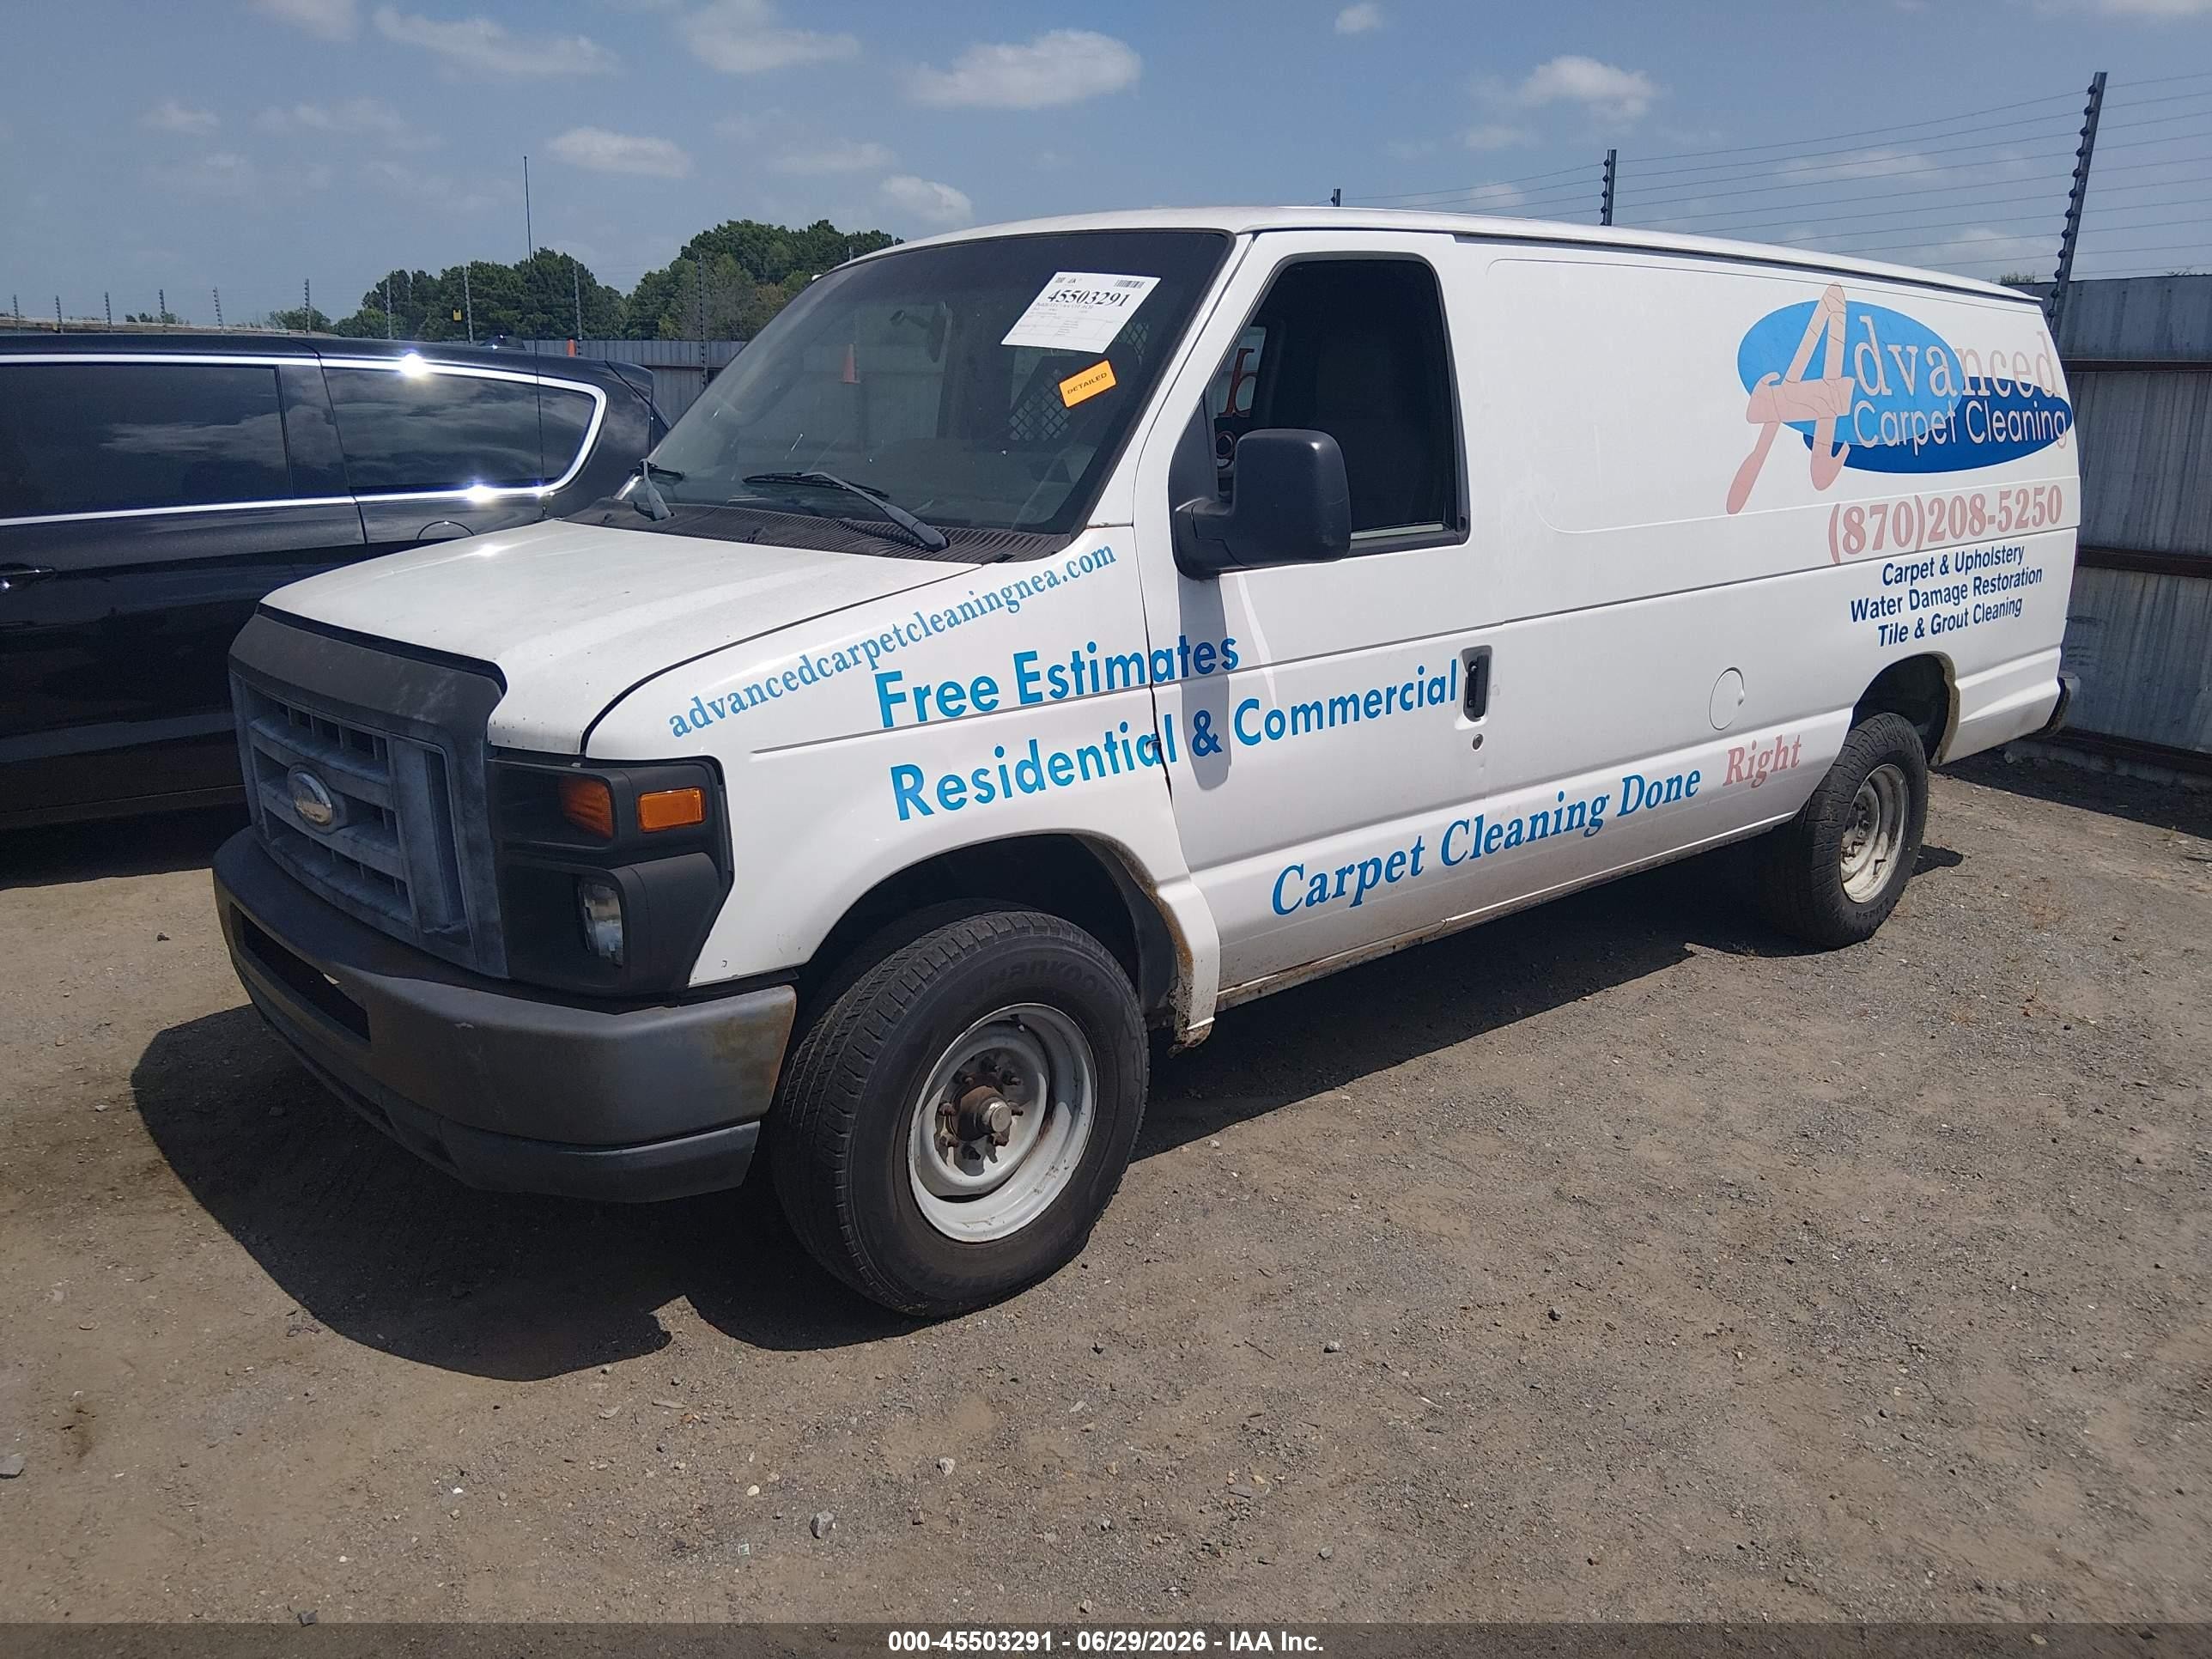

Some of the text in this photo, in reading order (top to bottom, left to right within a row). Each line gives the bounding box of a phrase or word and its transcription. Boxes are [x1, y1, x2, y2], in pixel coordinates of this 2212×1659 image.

[1048, 289, 1132, 307] 45503291
[1066, 372, 1108, 394] DETAILED
[1726, 282, 2062, 514] Advanced
[1853, 400, 2068, 455] Carpet Cleaning
[1828, 484, 2062, 565] (870)208-5250
[1850, 567, 2042, 623] Water Damage Restoration
[1882, 545, 2025, 586] Carpet & Upholstery
[669, 543, 1116, 738] advancedcarpetcleaningnea.com
[1878, 597, 2022, 647] Tile & Grout Cleaning
[875, 634, 1239, 728] Free Estimates
[891, 659, 1457, 822] Residential & Commercial
[1273, 732, 1802, 915] Carpet Cleaning Done Right
